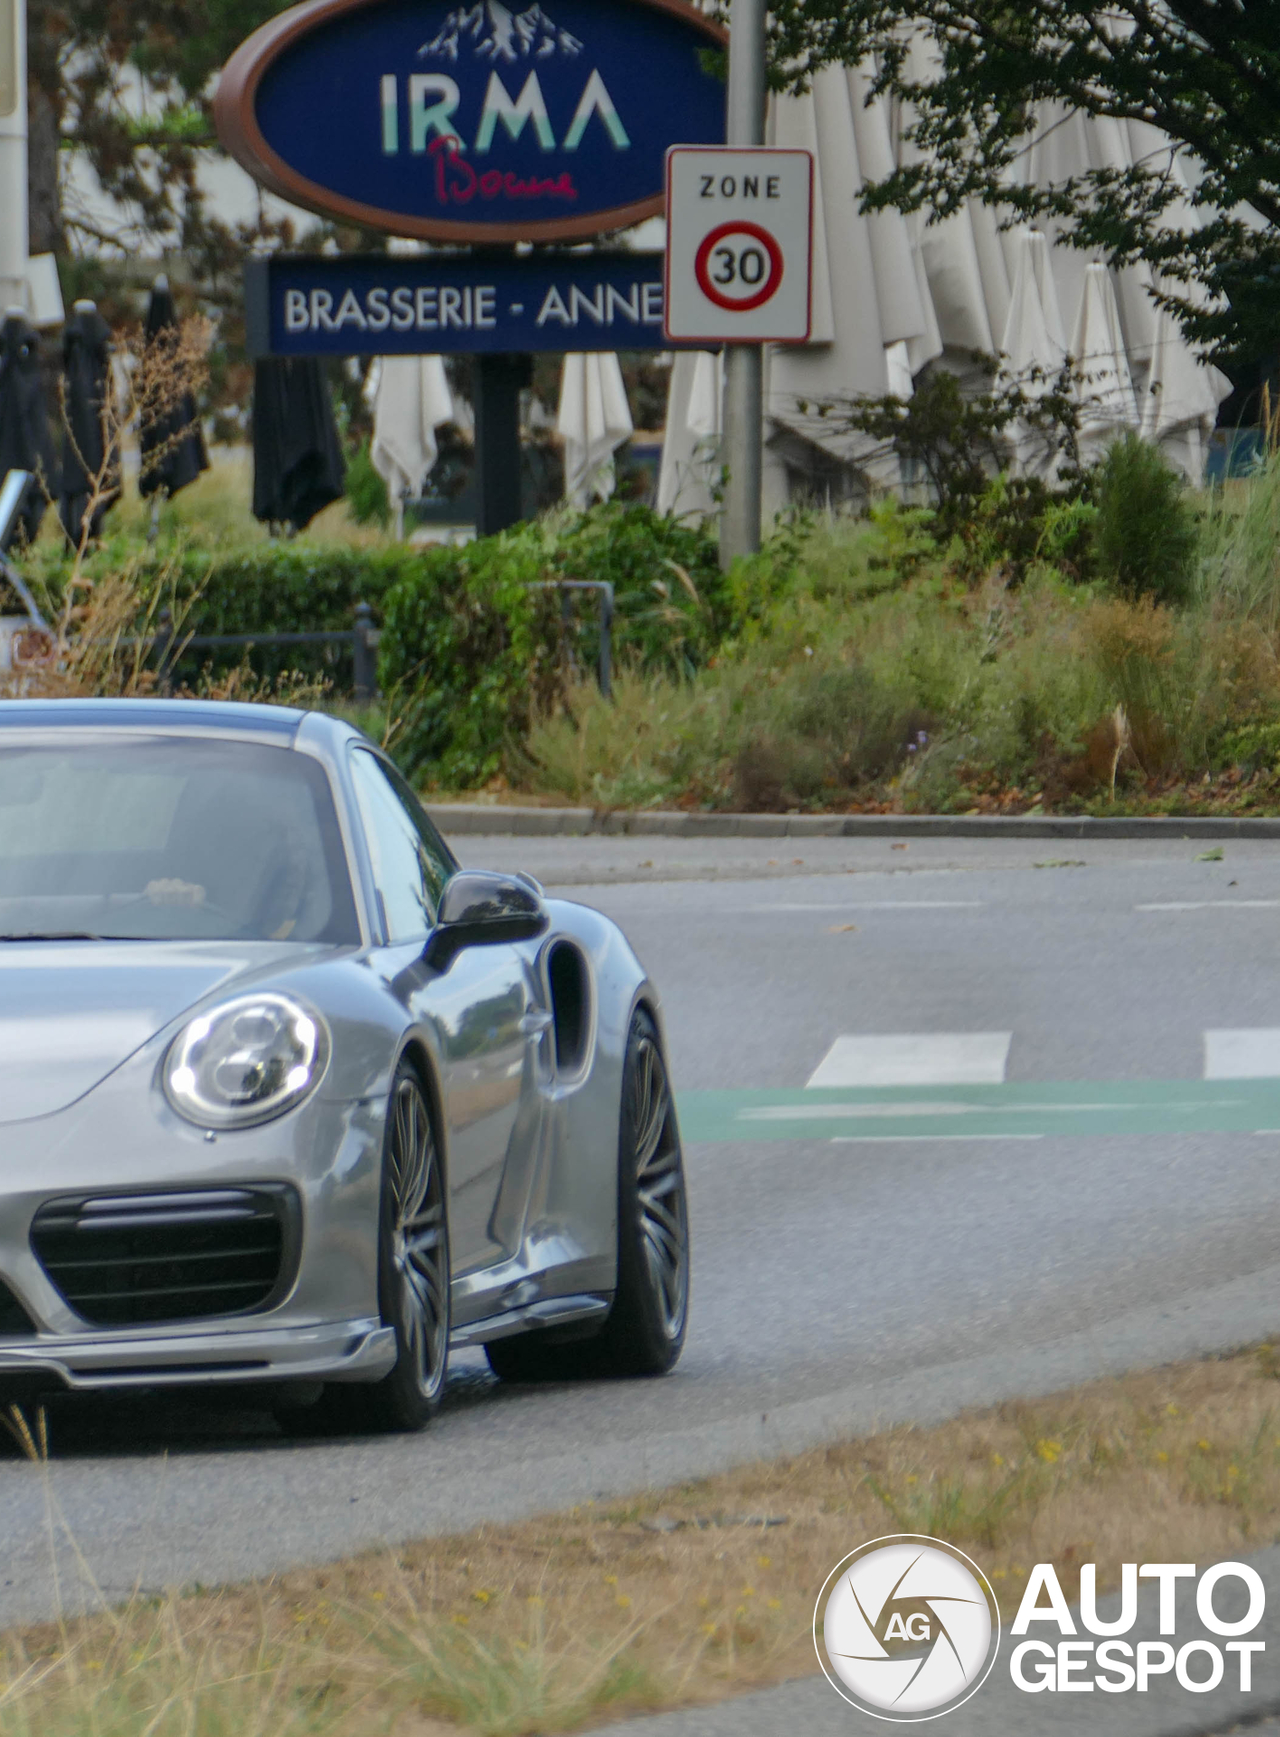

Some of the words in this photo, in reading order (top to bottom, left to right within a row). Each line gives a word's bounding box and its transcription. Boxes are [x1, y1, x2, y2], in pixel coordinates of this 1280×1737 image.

[380, 68, 631, 154] IRMA
[700, 175, 780, 199] ZONE
[713, 247, 765, 285] 30
[285, 286, 497, 331] BRASSERIE
